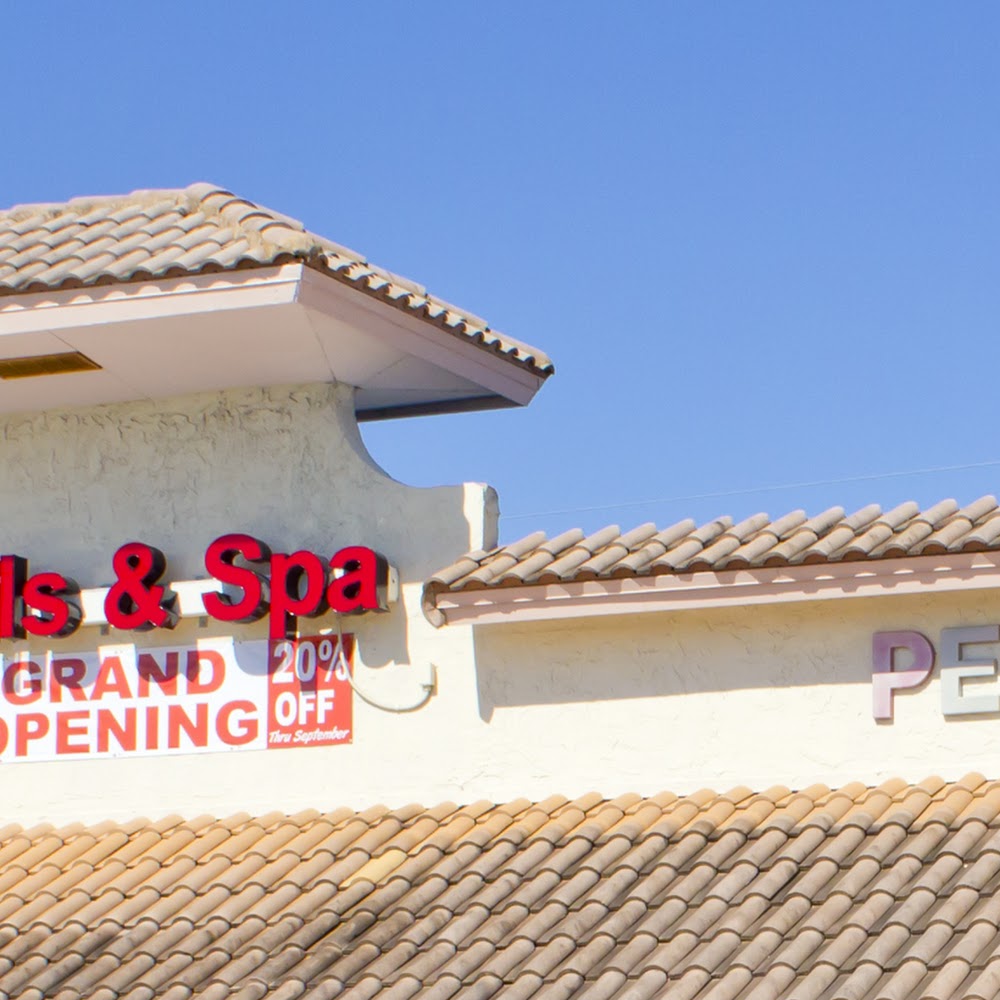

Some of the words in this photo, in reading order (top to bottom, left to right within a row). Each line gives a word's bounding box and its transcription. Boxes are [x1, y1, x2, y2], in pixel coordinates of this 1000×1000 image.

[104, 542, 170, 631] &
[202, 533, 382, 640] Spa
[2, 649, 226, 706] GRAND
[272, 638, 350, 684] 20%
[0, 700, 259, 757] PENING
[275, 689, 335, 727] OFF
[269, 730, 292, 744] Thru
[293, 726, 350, 744] September
